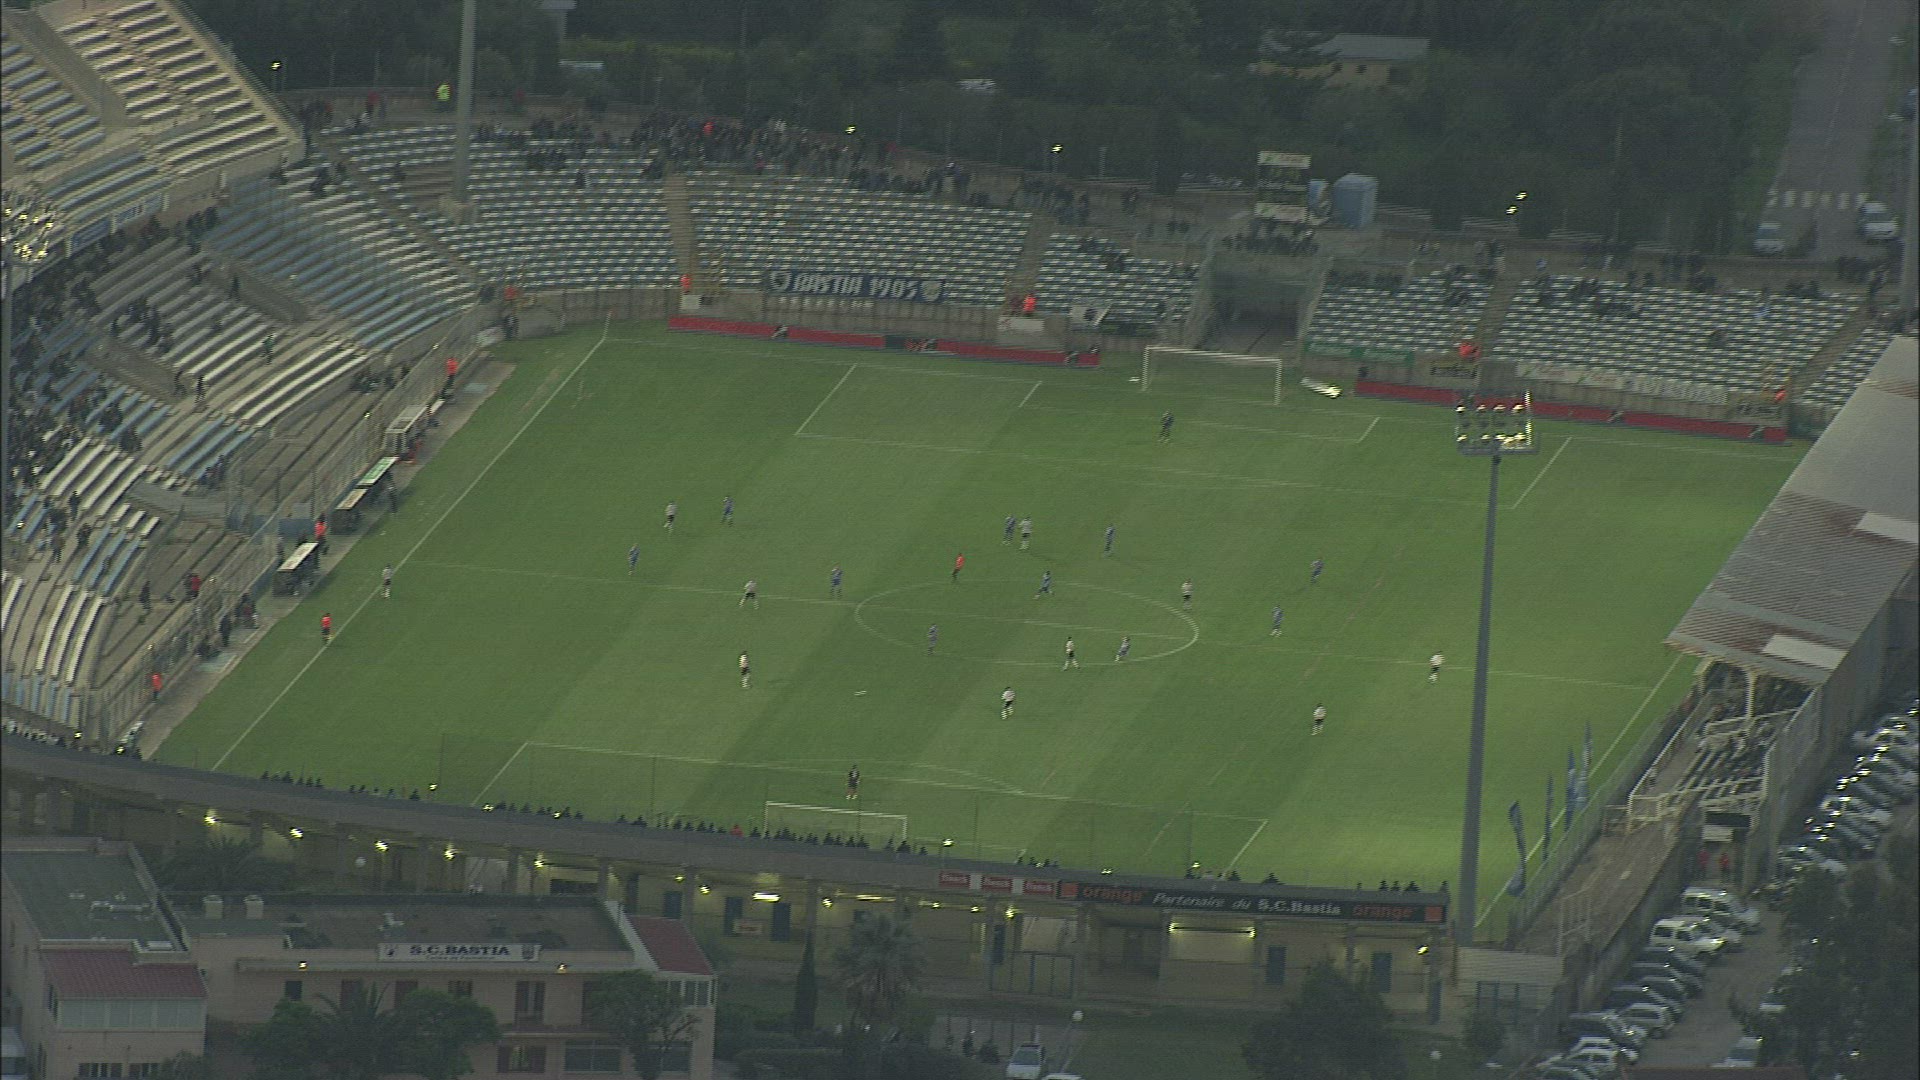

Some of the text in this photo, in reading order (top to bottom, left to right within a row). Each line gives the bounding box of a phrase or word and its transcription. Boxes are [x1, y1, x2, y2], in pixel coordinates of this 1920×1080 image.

[792, 272, 918, 298] BASTIA 1905
[1082, 886, 1143, 904] orange
[1152, 893, 1225, 910] Partenaire
[1231, 898, 1252, 911] du
[1352, 905, 1414, 922] orange
